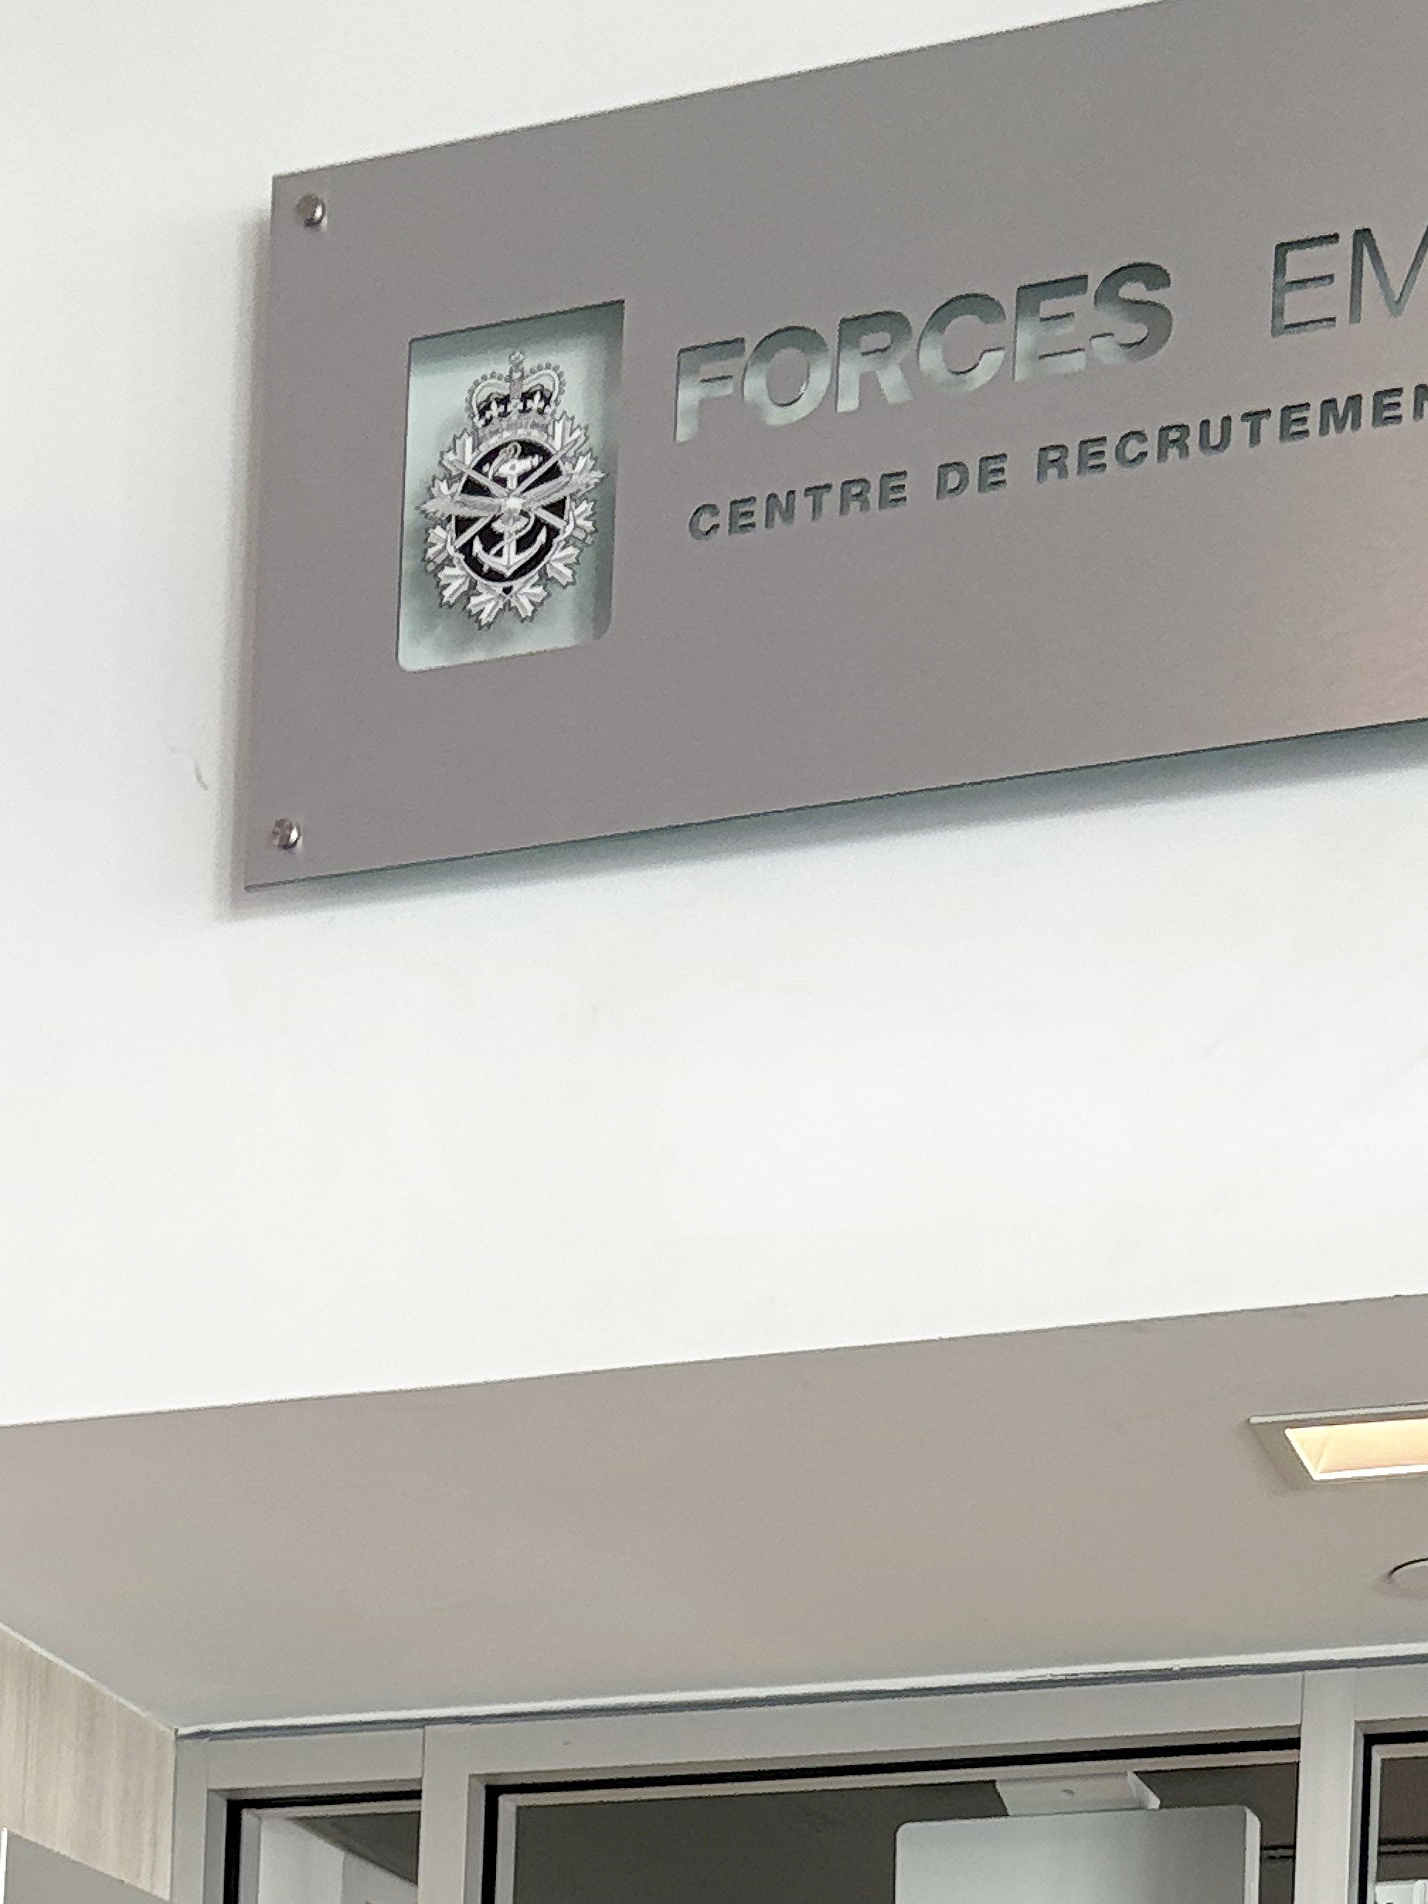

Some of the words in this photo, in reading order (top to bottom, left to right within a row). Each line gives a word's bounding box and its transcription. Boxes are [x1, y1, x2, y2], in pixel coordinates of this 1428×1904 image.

[675, 262, 1172, 443] FORCES
[688, 470, 909, 542] CENTRE
[936, 453, 1009, 500] DE
